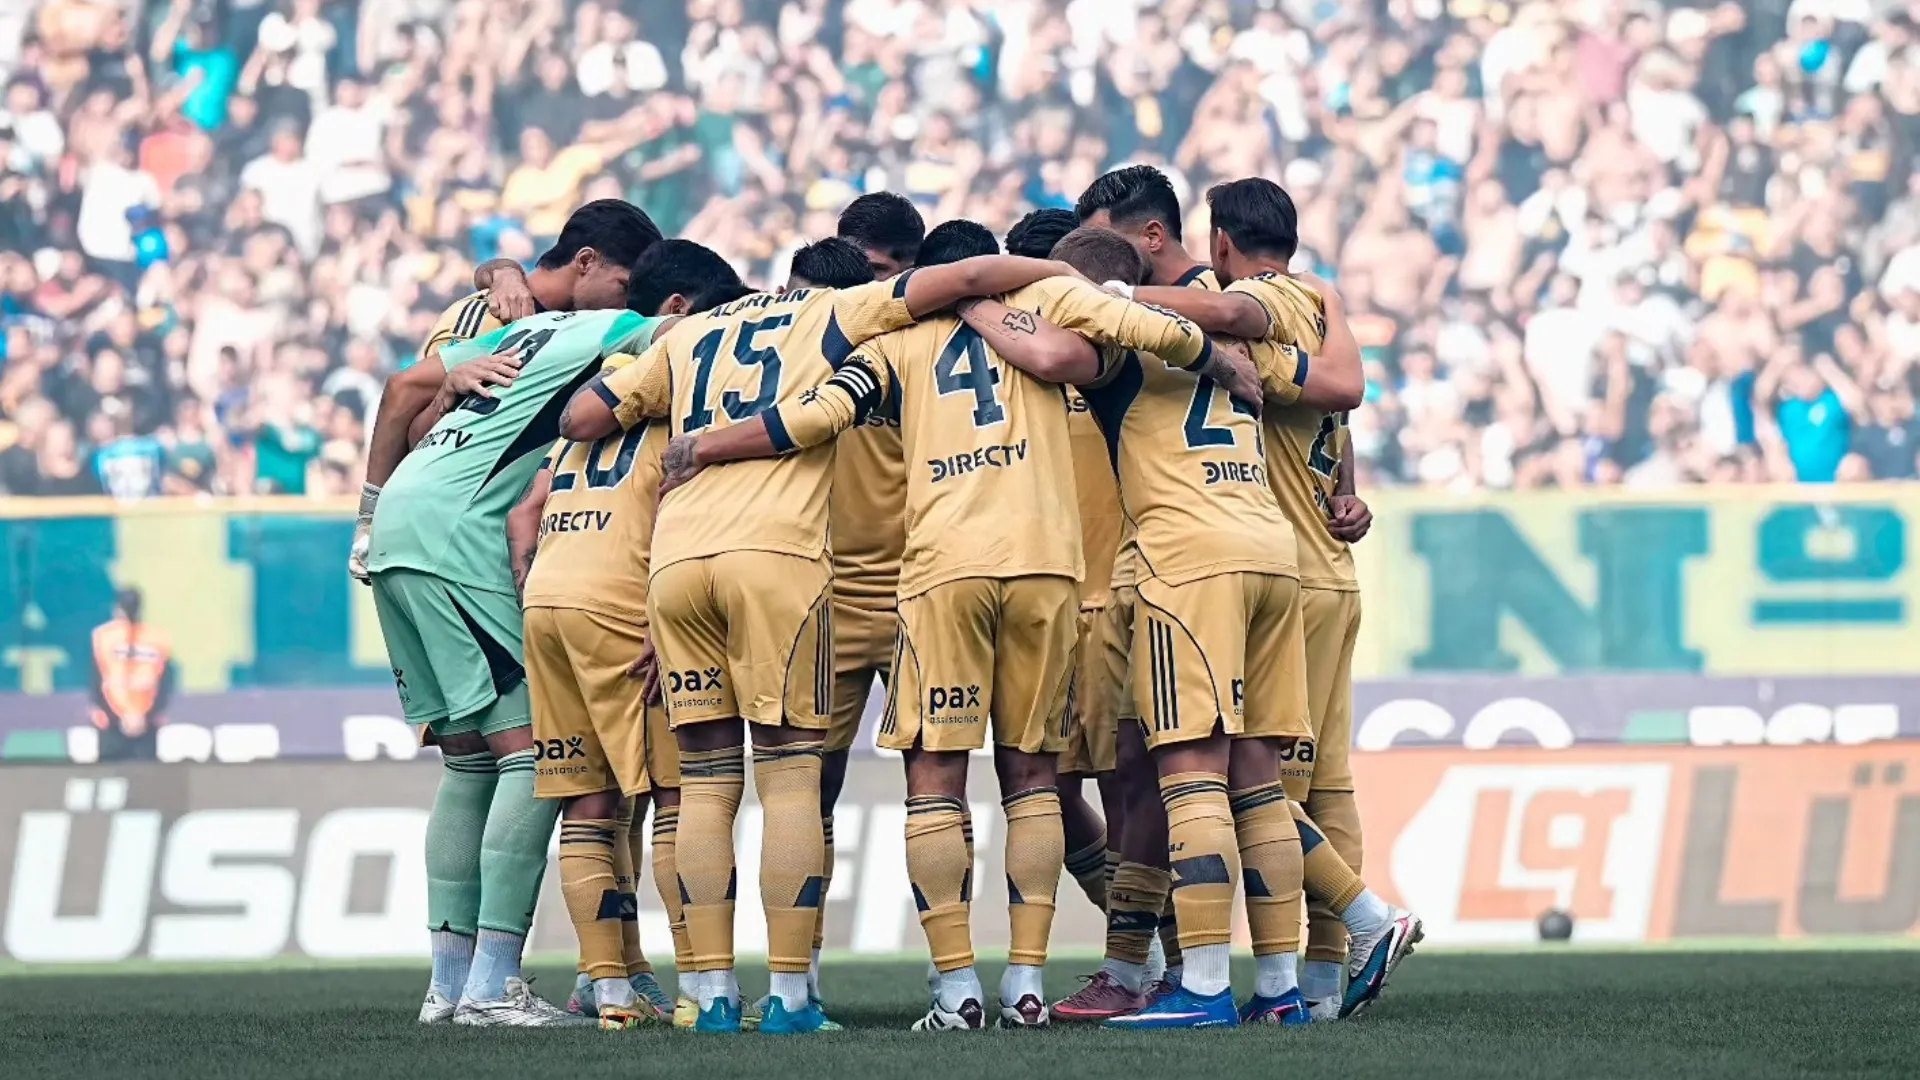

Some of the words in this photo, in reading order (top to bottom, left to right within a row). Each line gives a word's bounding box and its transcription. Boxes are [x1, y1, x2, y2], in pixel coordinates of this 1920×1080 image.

[682, 312, 794, 435] 15
[932, 317, 1006, 428] 4
[927, 438, 1028, 483] DIRECTV
[929, 684, 980, 715] pax
[929, 715, 979, 725] assistance
[534, 765, 588, 776] ssistance
